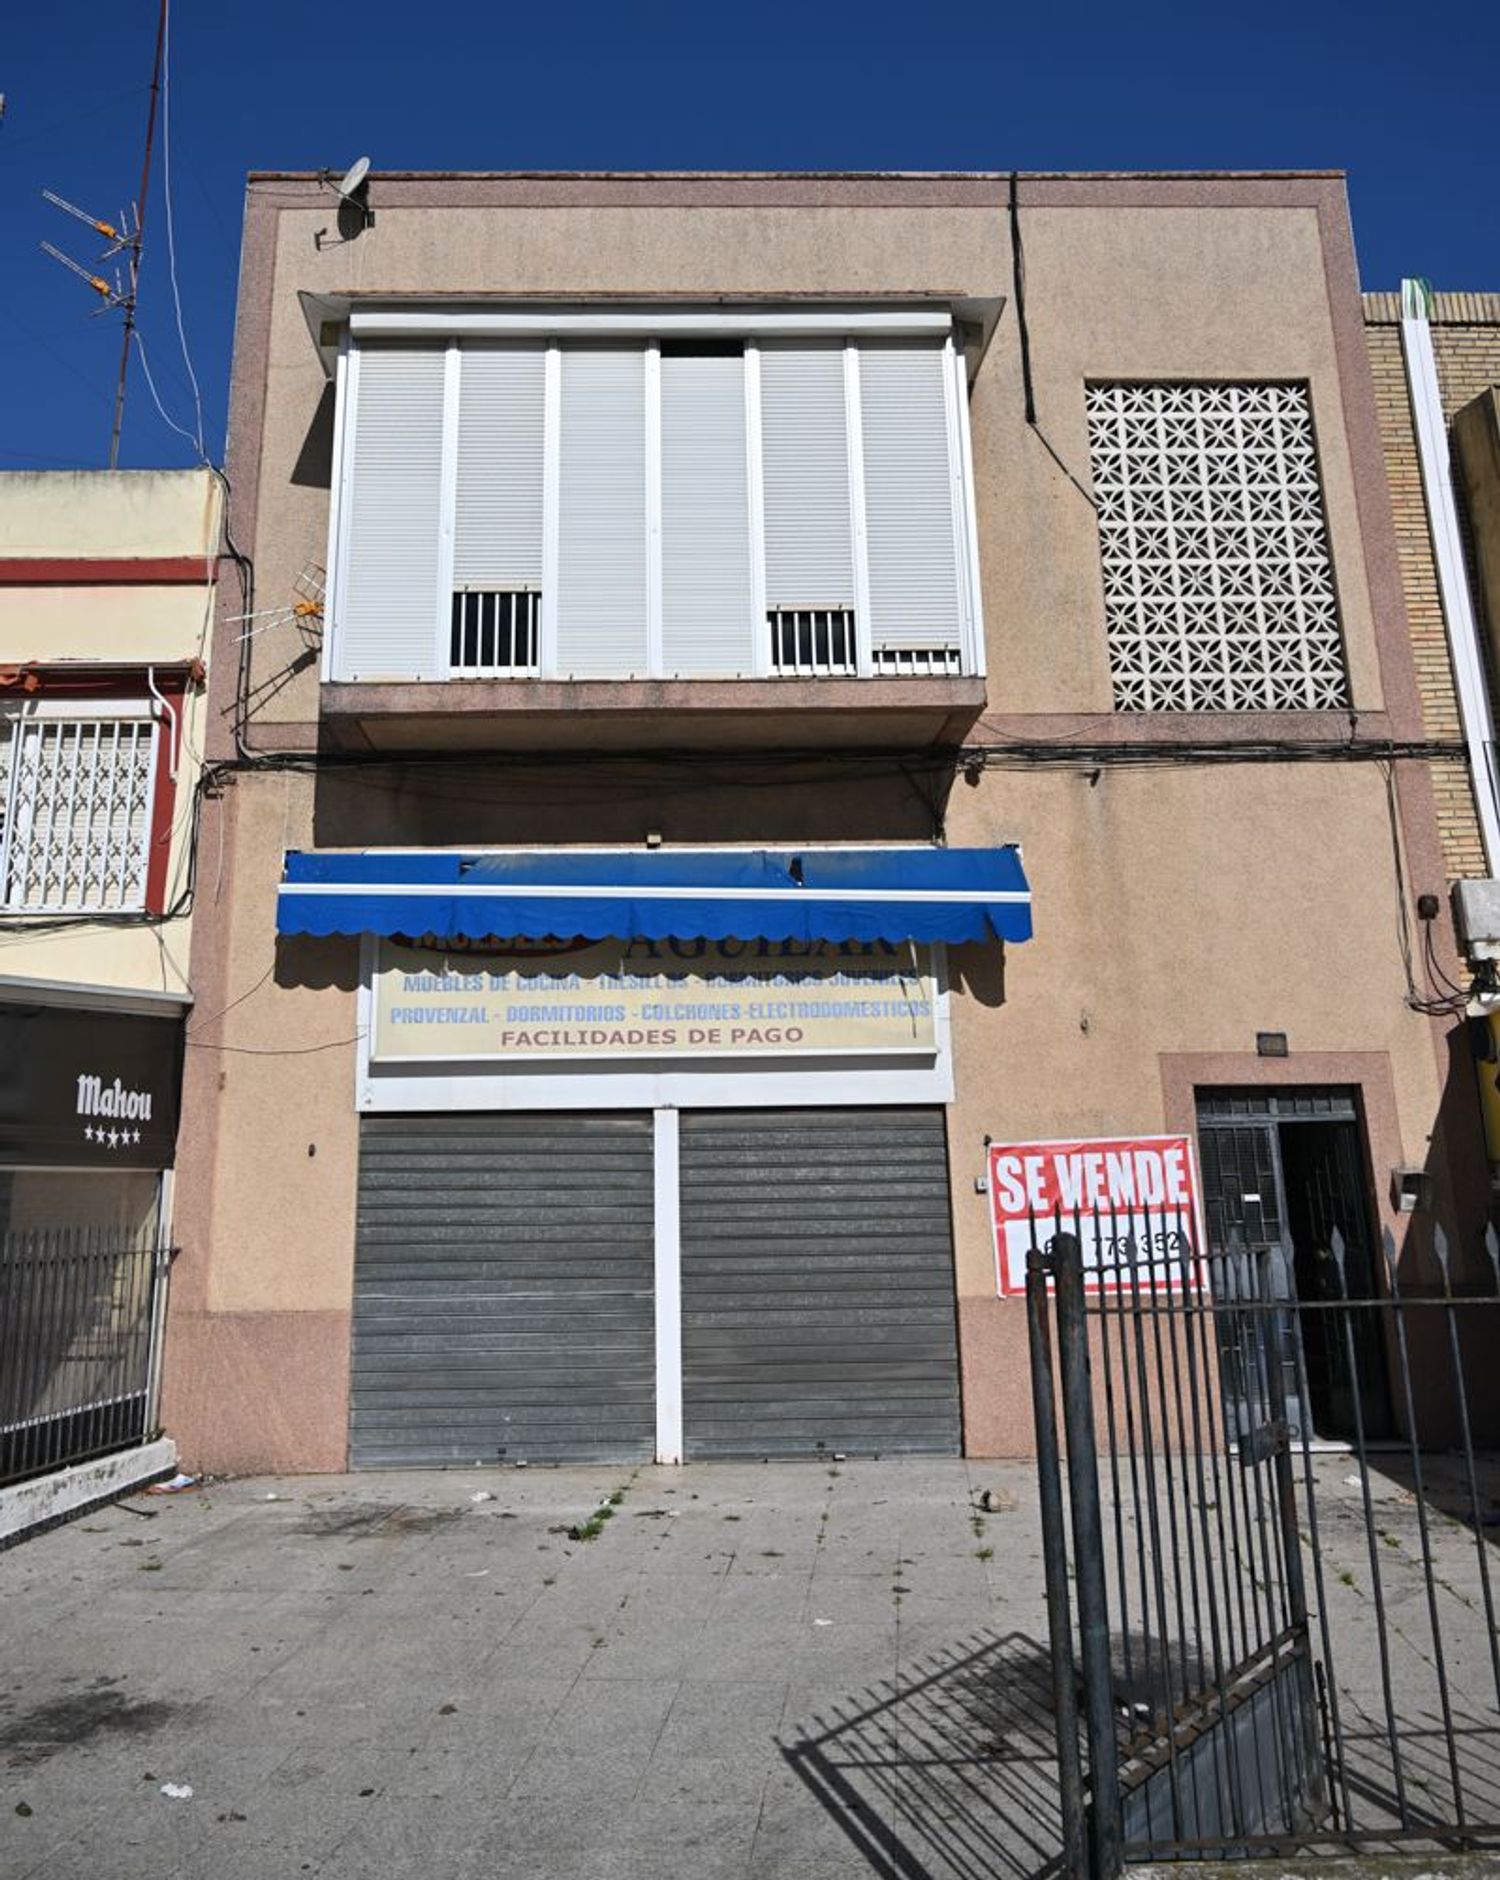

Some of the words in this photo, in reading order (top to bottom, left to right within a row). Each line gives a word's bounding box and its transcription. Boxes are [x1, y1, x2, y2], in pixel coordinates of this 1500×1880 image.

[489, 974, 512, 991] DE
[390, 1007, 490, 1024] PROVENZAL
[507, 1004, 625, 1022] DORMITORIOS
[501, 1029, 677, 1047] FACILIDADES
[688, 1028, 722, 1044] DE
[731, 1027, 804, 1044] PAGO
[76, 1073, 152, 1121] Mahou
[996, 1154, 1050, 1213] SE
[1053, 1148, 1189, 1212] VENDE
